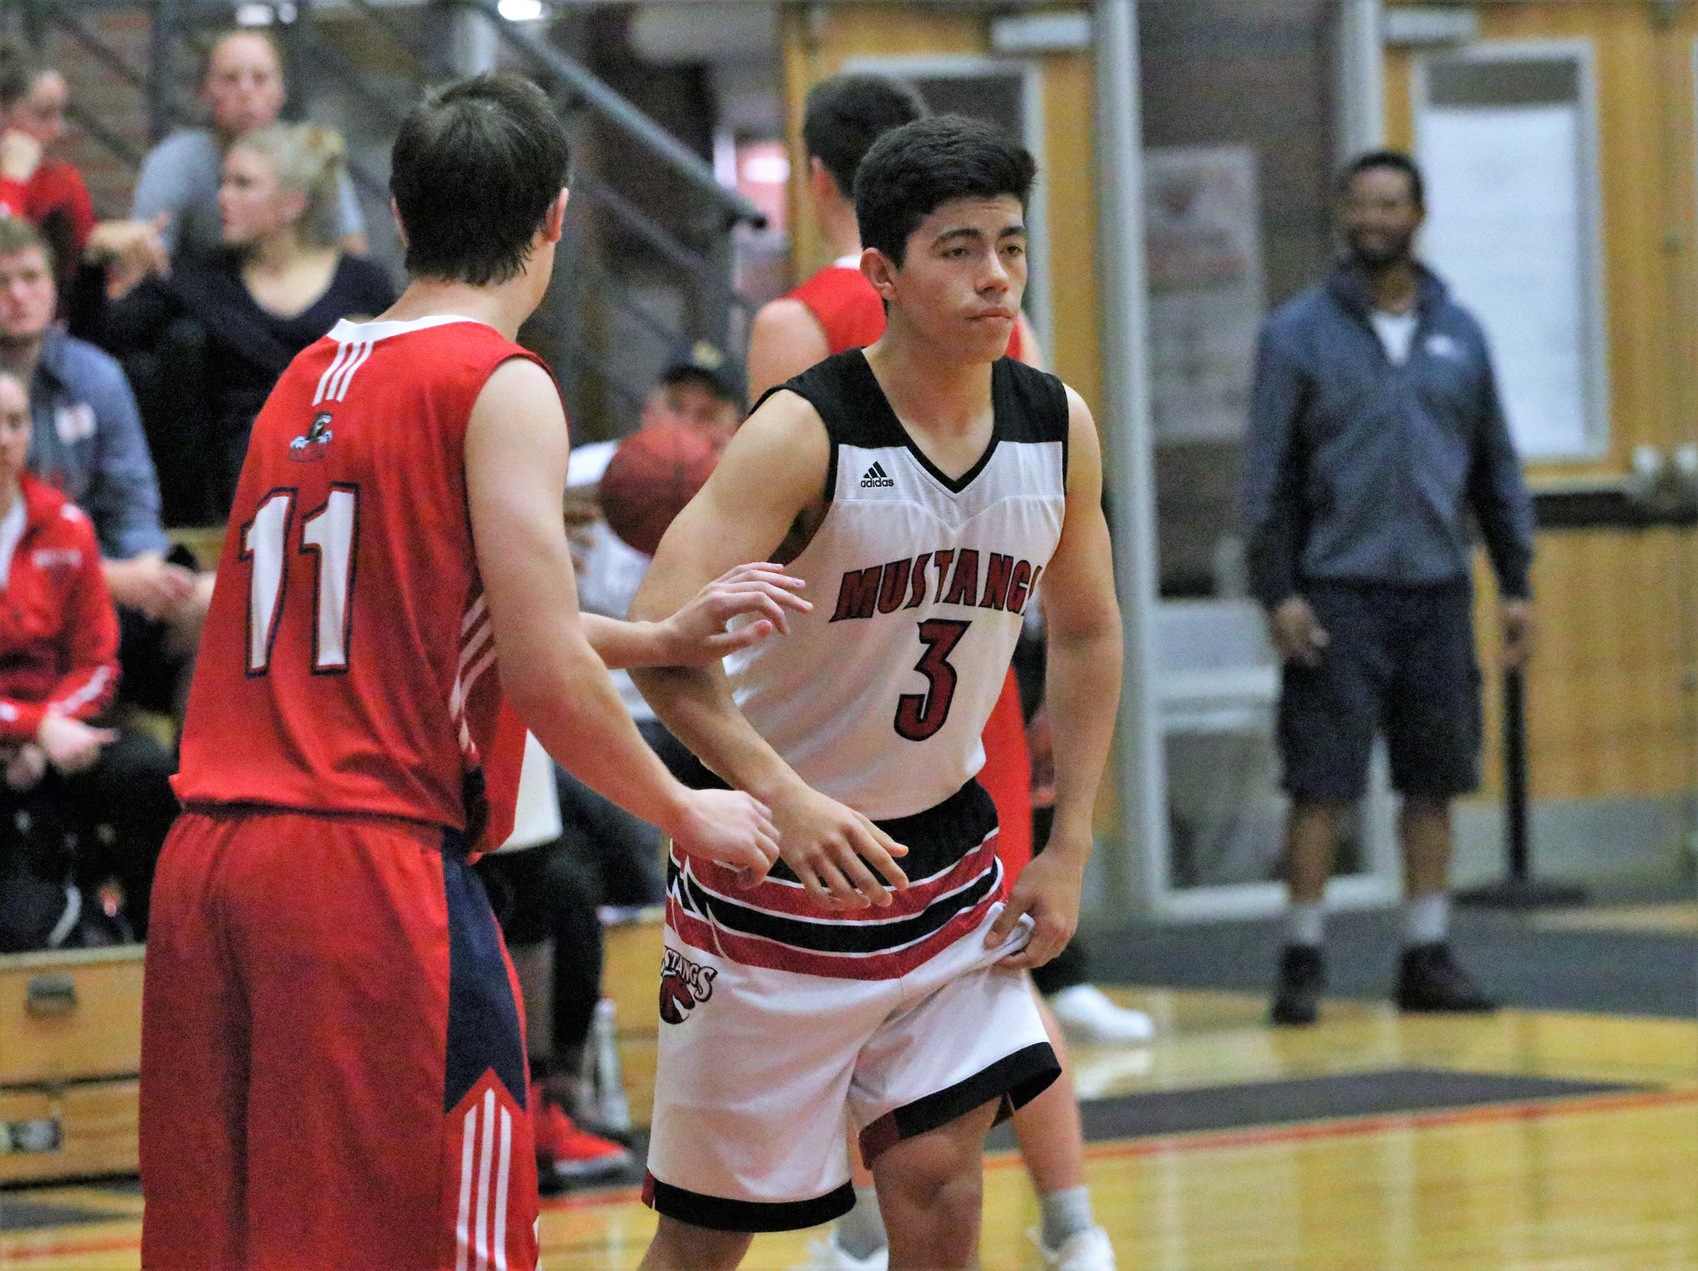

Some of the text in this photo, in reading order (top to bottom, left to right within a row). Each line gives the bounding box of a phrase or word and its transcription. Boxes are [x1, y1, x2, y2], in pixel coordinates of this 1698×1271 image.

[860, 477, 894, 488] adidas
[239, 481, 361, 679] 11
[893, 618, 973, 742] 3
